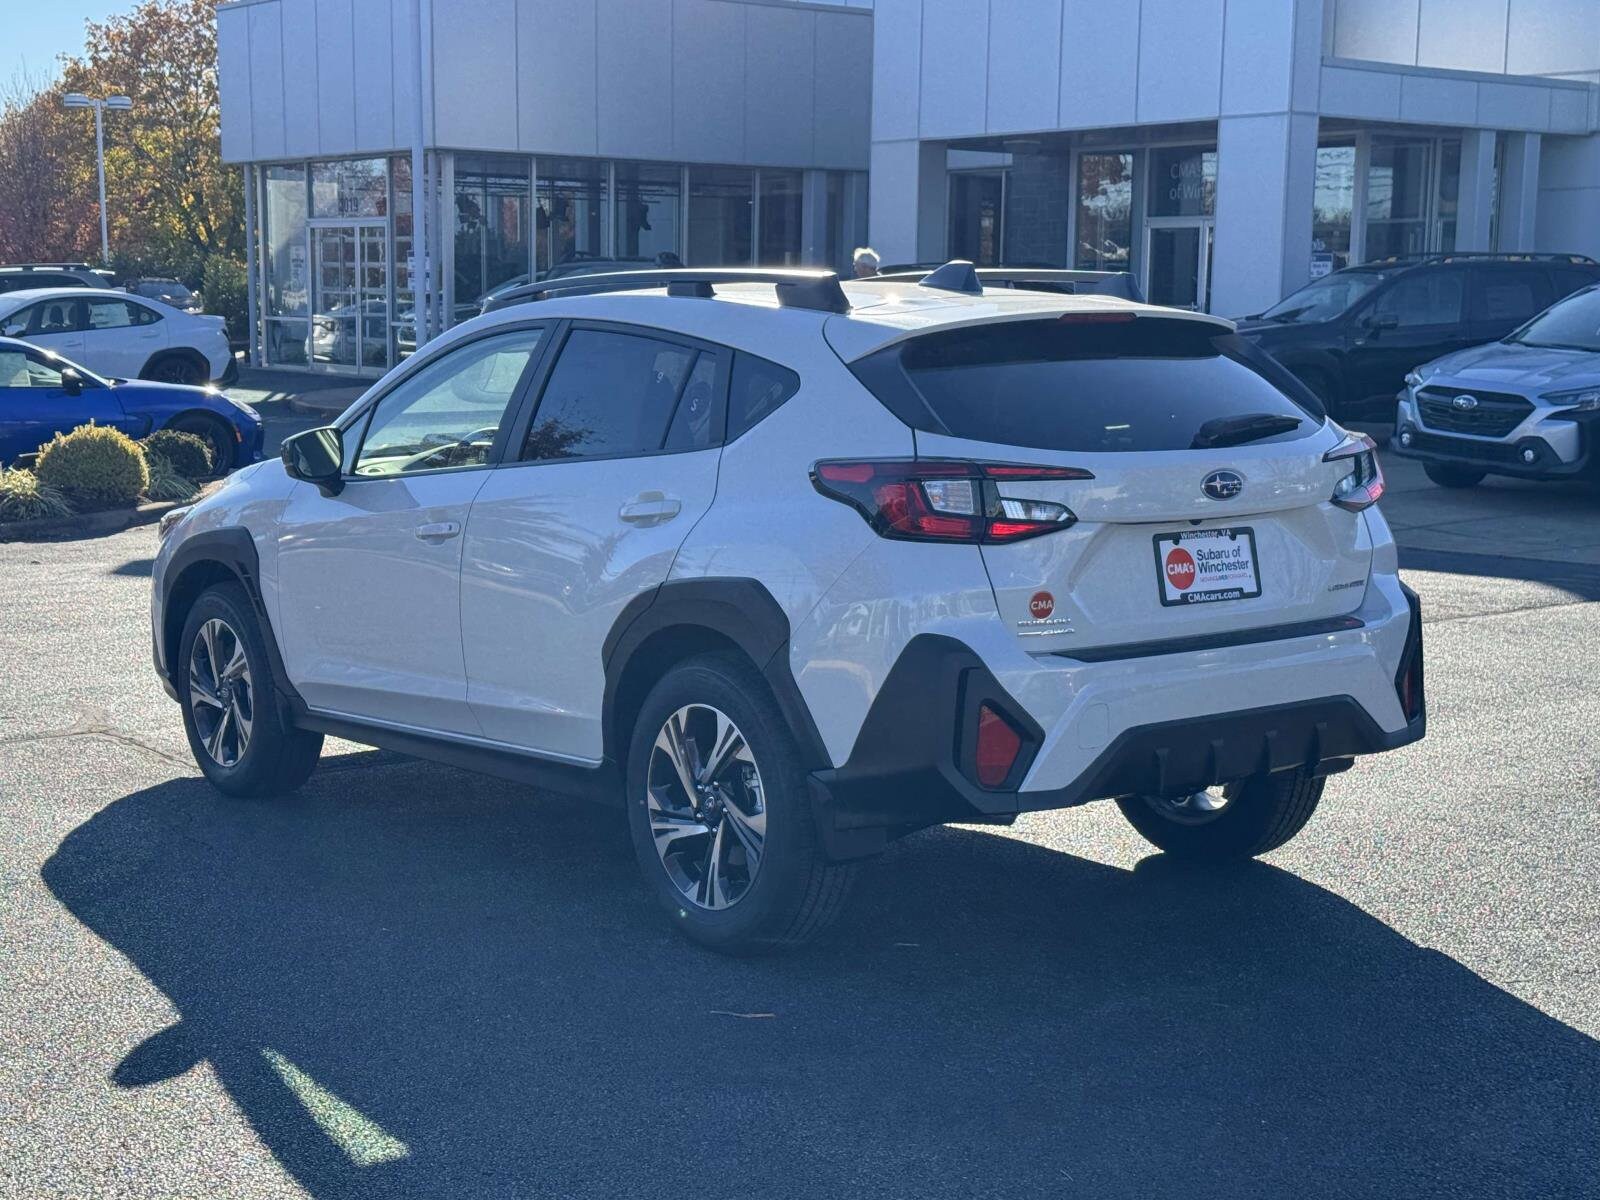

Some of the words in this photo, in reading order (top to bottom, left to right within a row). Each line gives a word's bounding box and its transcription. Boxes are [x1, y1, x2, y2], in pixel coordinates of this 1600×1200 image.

[1197, 549, 1230, 561] Subaru
[1231, 546, 1241, 559] of
[1167, 562, 1194, 575] CMA's
[1197, 559, 1250, 574] Winchester
[1188, 590, 1240, 602] CMAcars.com
[1030, 600, 1053, 610] CMA
